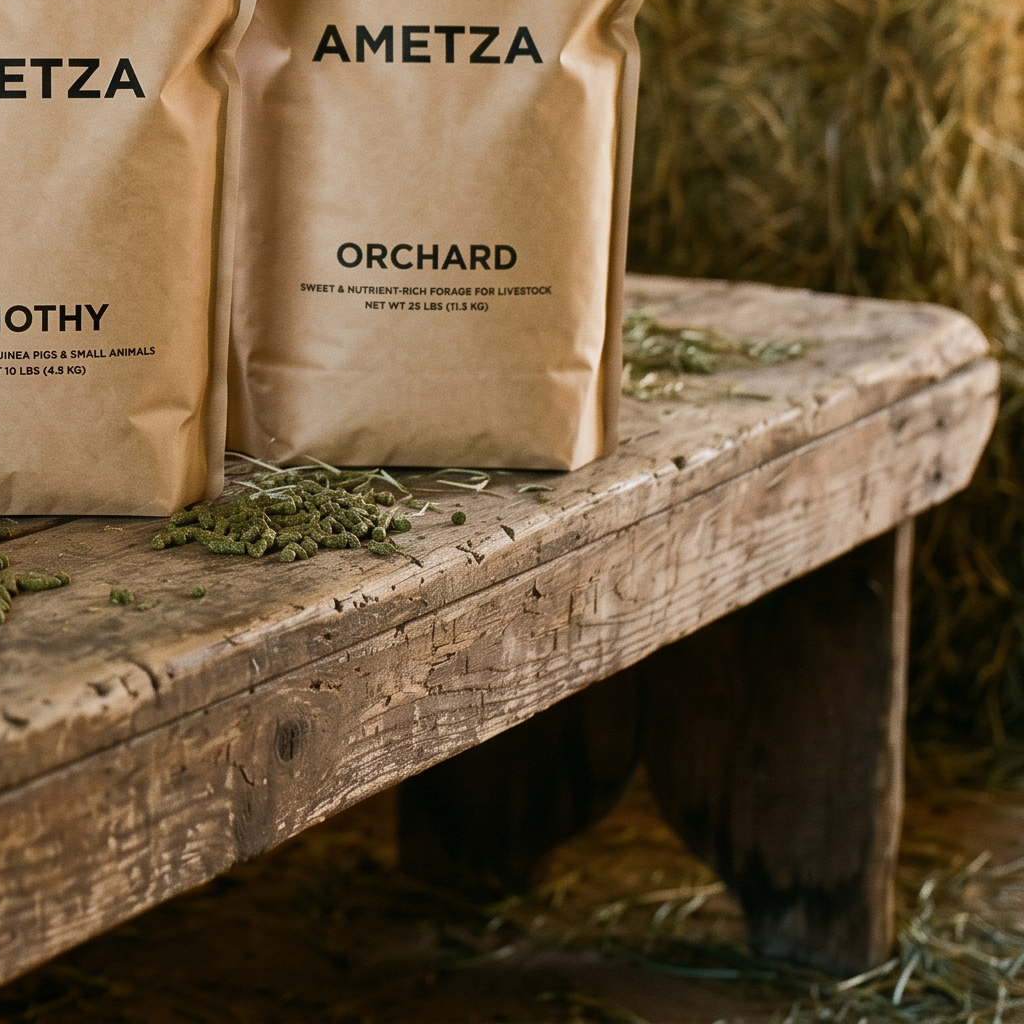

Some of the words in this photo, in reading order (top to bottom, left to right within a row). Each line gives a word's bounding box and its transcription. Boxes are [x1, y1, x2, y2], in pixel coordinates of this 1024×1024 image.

[312, 24, 543, 64] AMETZA
[337, 242, 517, 270] ORCHARD
[300, 282, 336, 293] SWEET
[337, 284, 345, 294] &
[347, 285, 427, 296] NUTRIENT-RICH
[429, 286, 472, 297] FORAGE
[474, 286, 496, 297] FOR
[497, 285, 553, 296] LIVESTOCK
[364, 300, 386, 310] NET
[388, 301, 406, 311] WT
[423, 301, 444, 312] LBS
[470, 301, 490, 313] KG)
[32, 350, 58, 360] PIGS
[59, 349, 68, 360] &
[70, 348, 107, 359] SMALL
[108, 346, 156, 358] ANIMALS
[4, 366, 17, 376] 10
[19, 366, 41, 376] LBS
[66, 365, 87, 377] KG)
